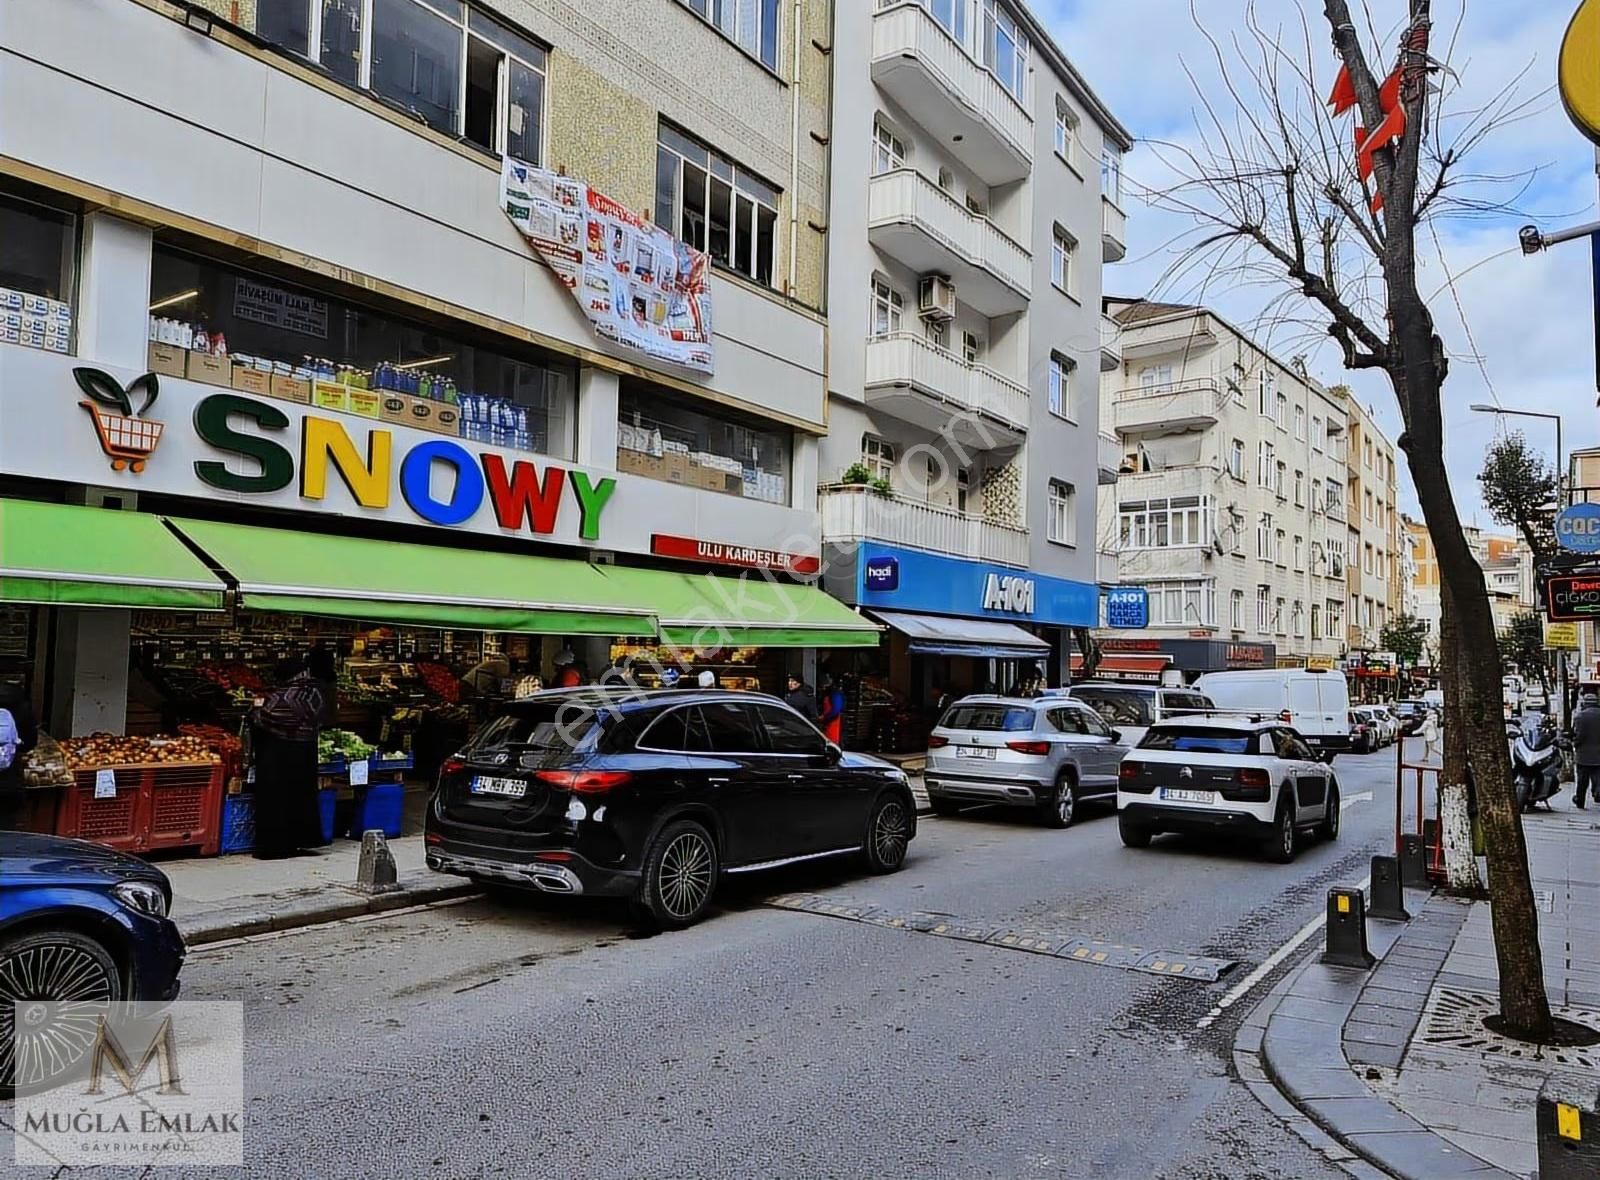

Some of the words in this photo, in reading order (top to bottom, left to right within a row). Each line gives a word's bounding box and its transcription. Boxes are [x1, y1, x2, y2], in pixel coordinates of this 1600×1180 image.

[193, 393, 617, 541] SNOWY
[698, 541, 722, 557] ULU
[726, 546, 791, 568] KARDEŞLER
[869, 565, 891, 576] hadi
